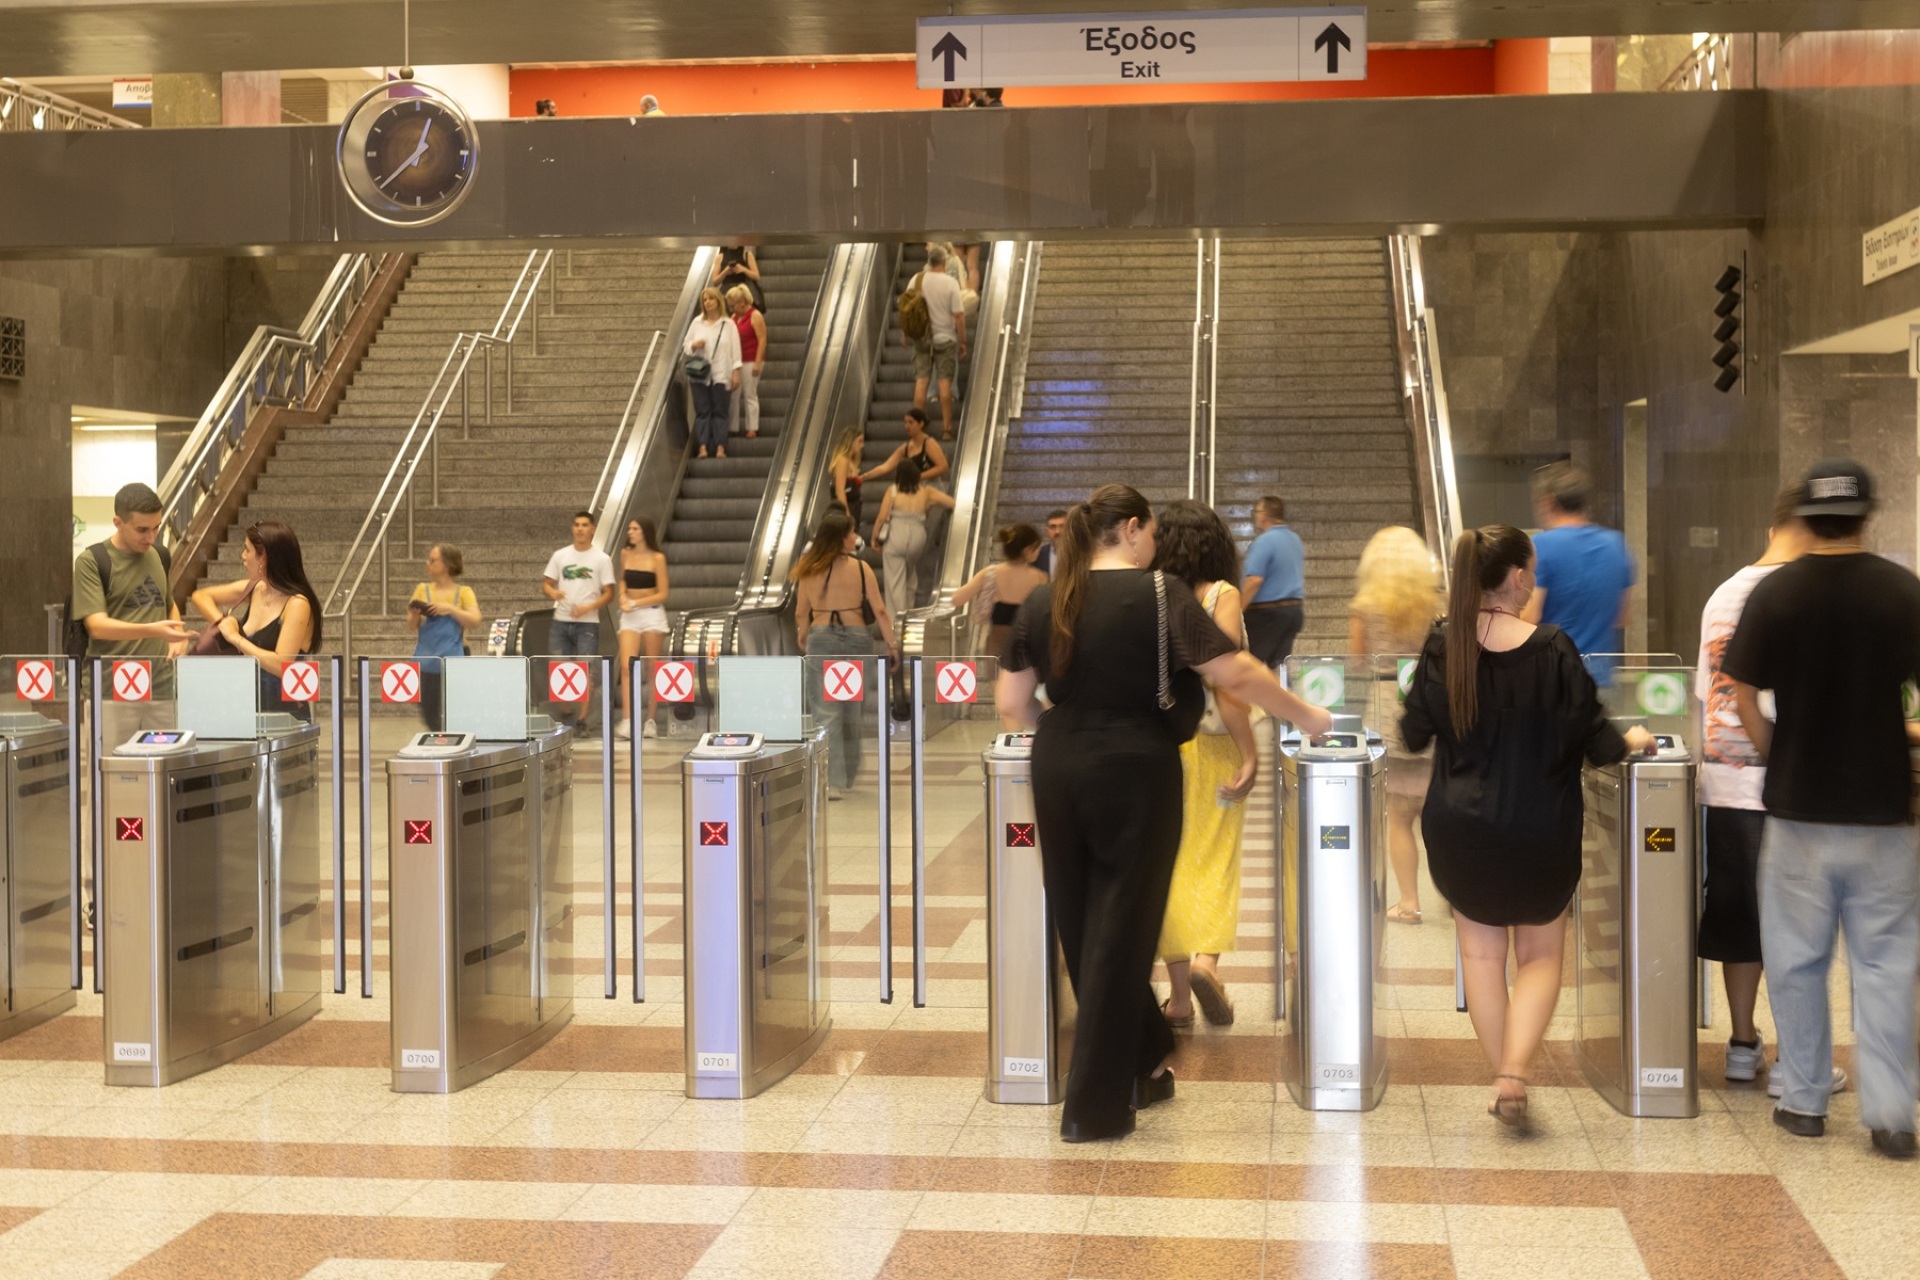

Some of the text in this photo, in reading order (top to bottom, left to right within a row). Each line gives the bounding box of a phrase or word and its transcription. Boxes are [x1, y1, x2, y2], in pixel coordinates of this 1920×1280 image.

[1080, 26, 1196, 56] Έξοδος
[1121, 61, 1160, 78] Exit
[126, 83, 152, 94] Αποβ
[119, 1048, 146, 1056] 0699
[407, 1054, 435, 1064] 0700
[703, 1057, 730, 1066] 0701
[1009, 1062, 1039, 1073] 0702
[1323, 1068, 1354, 1079] 0703
[1647, 1073, 1679, 1083] 0704
